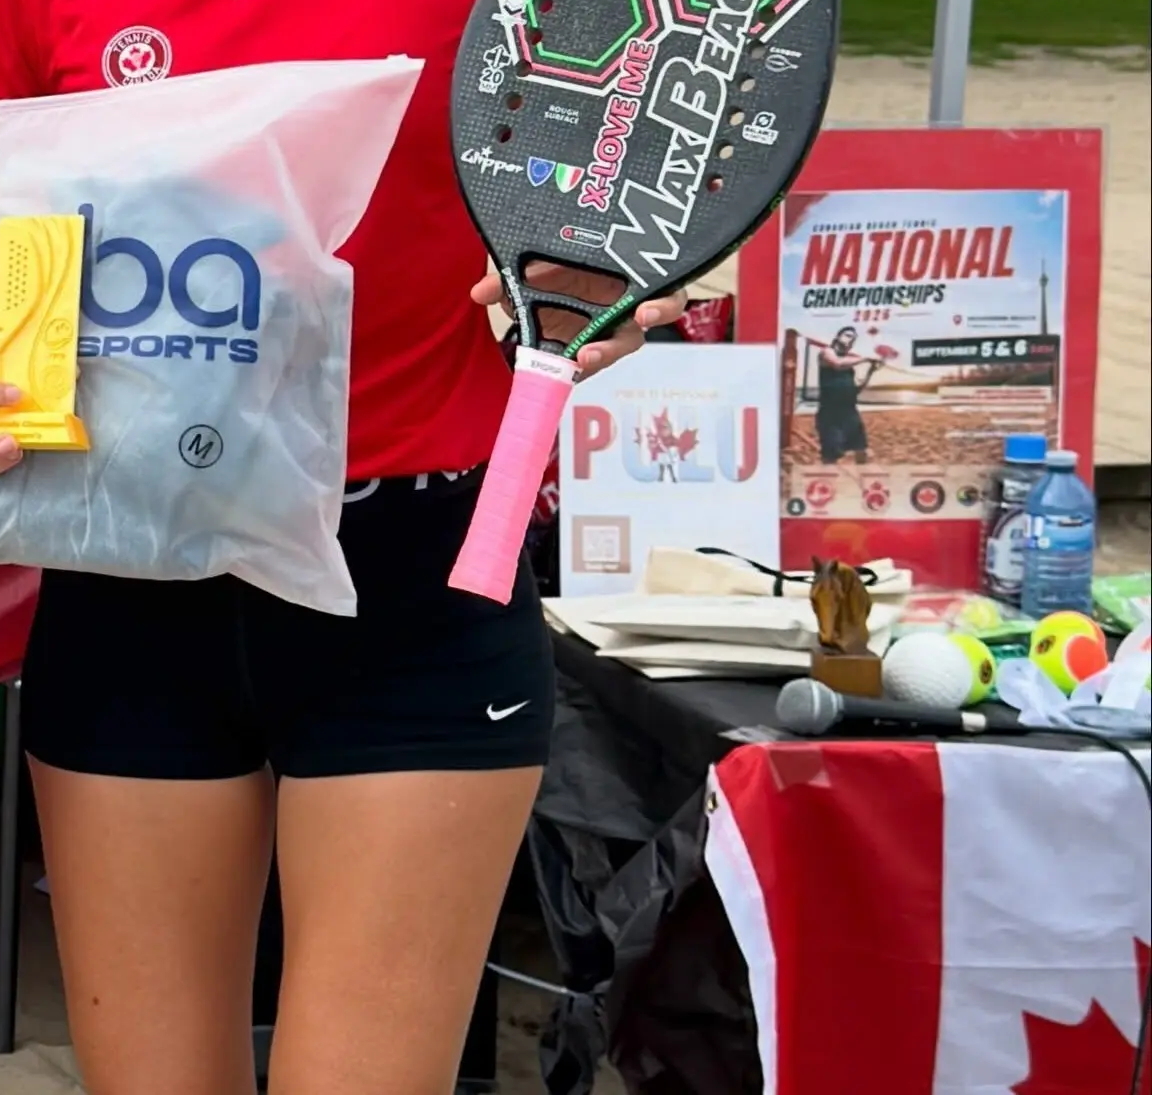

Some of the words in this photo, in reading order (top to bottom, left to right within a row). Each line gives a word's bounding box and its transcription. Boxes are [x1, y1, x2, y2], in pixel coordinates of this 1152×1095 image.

[113, 32, 152, 53] TENNIS
[482, 70, 502, 84] 20
[544, 111, 579, 125] SURFACE
[549, 105, 579, 117] ROUGH
[579, 95, 637, 211] X-LOVE
[627, 38, 655, 95] ME
[800, 226, 1014, 286] NATIONAL
[802, 284, 946, 309] CHAMPIONSHIPS
[77, 335, 259, 364] SPORTS
[915, 345, 979, 358] SEPTEMBER
[980, 341, 994, 358] 5
[995, 341, 1012, 357] &
[1014, 339, 1028, 356] 6
[186, 433, 214, 461] M
